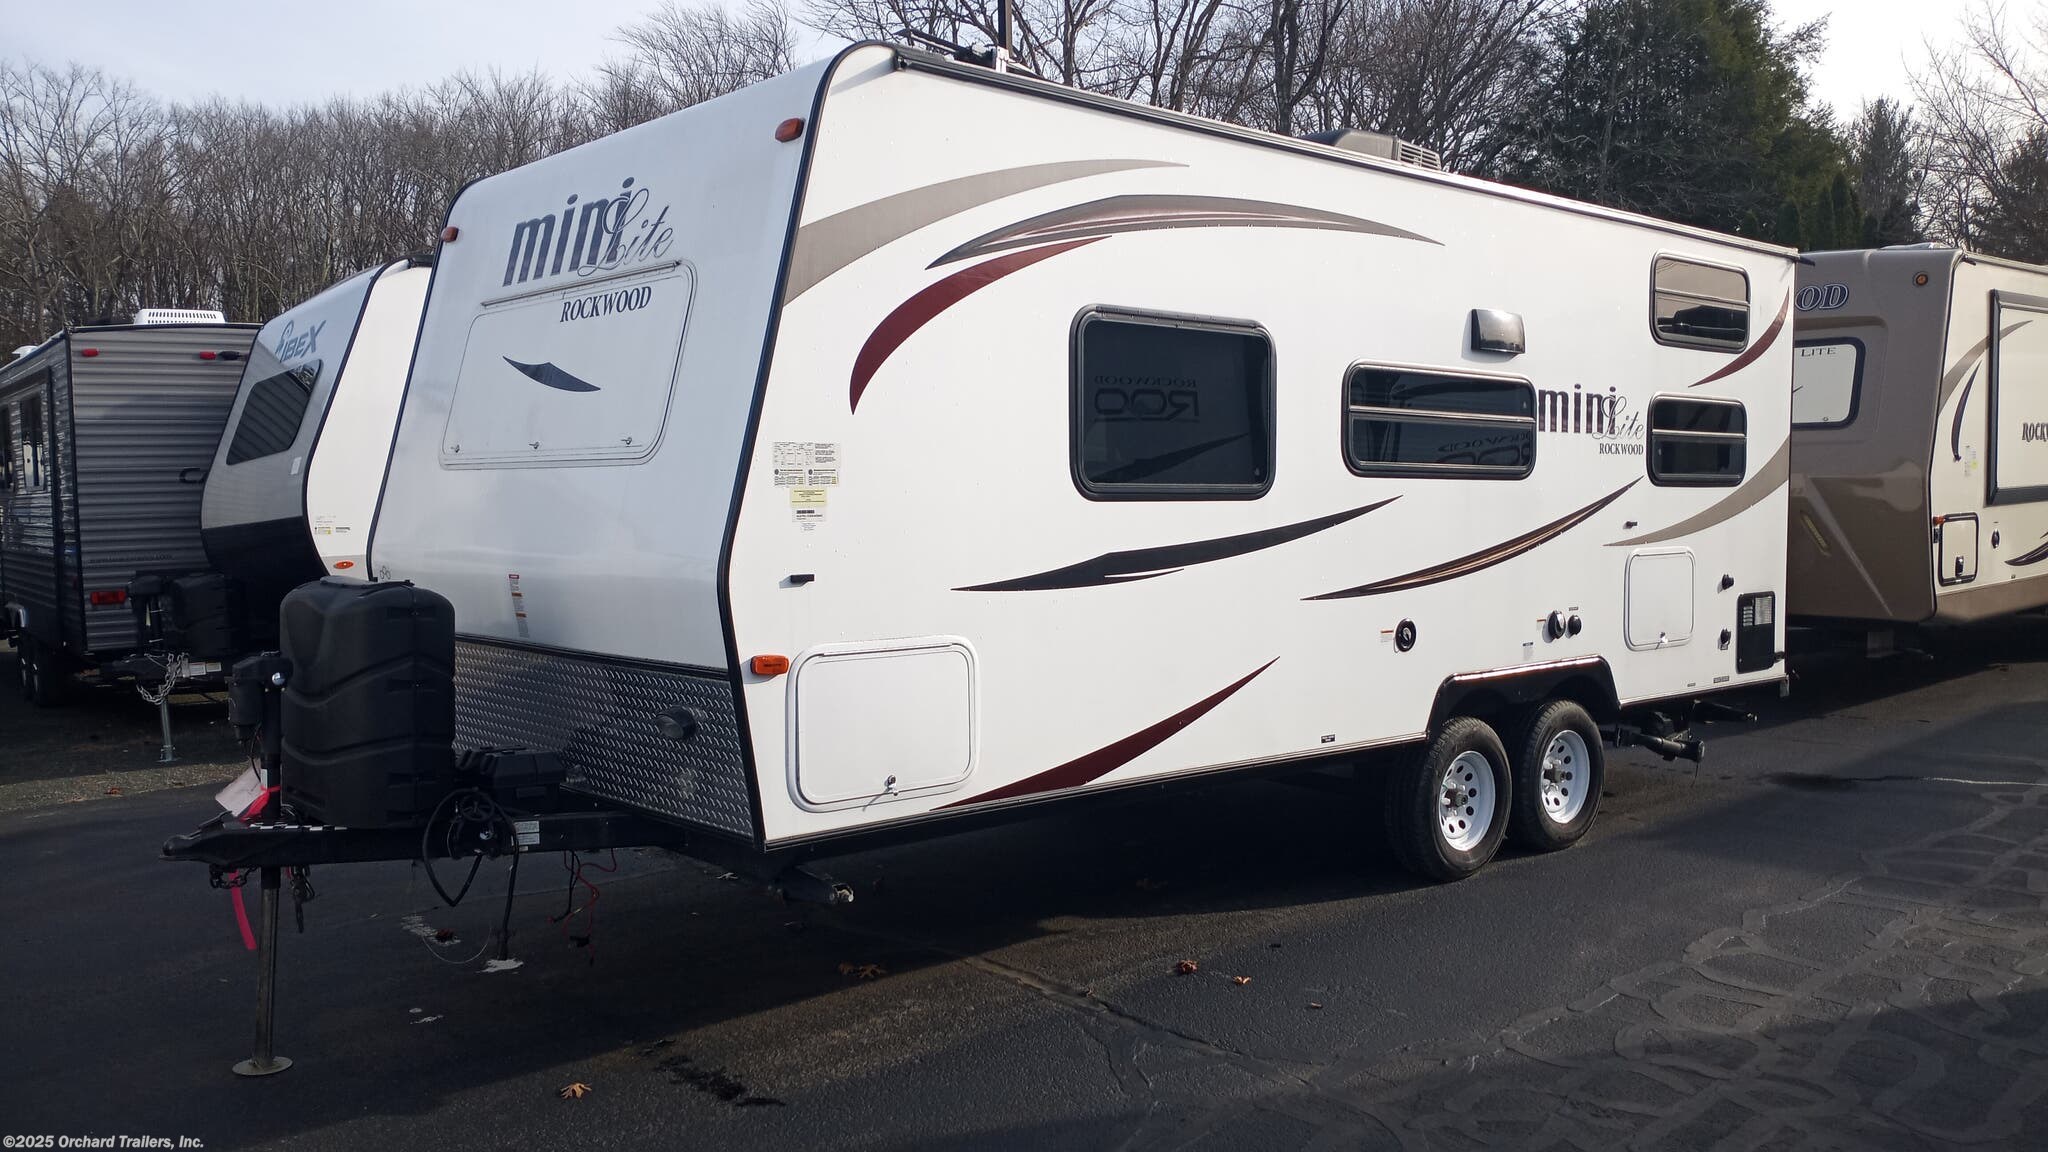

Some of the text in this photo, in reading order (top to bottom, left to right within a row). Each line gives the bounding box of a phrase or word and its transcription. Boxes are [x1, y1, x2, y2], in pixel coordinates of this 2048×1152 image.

[502, 176, 674, 287] mini Lite
[559, 286, 652, 323] ROCKWOOD
[1801, 346, 1837, 358] LITE
[1538, 383, 1646, 441] mini Lite
[2021, 421, 2048, 443] ROCK
[1598, 442, 1645, 456] ROCKWOOD
